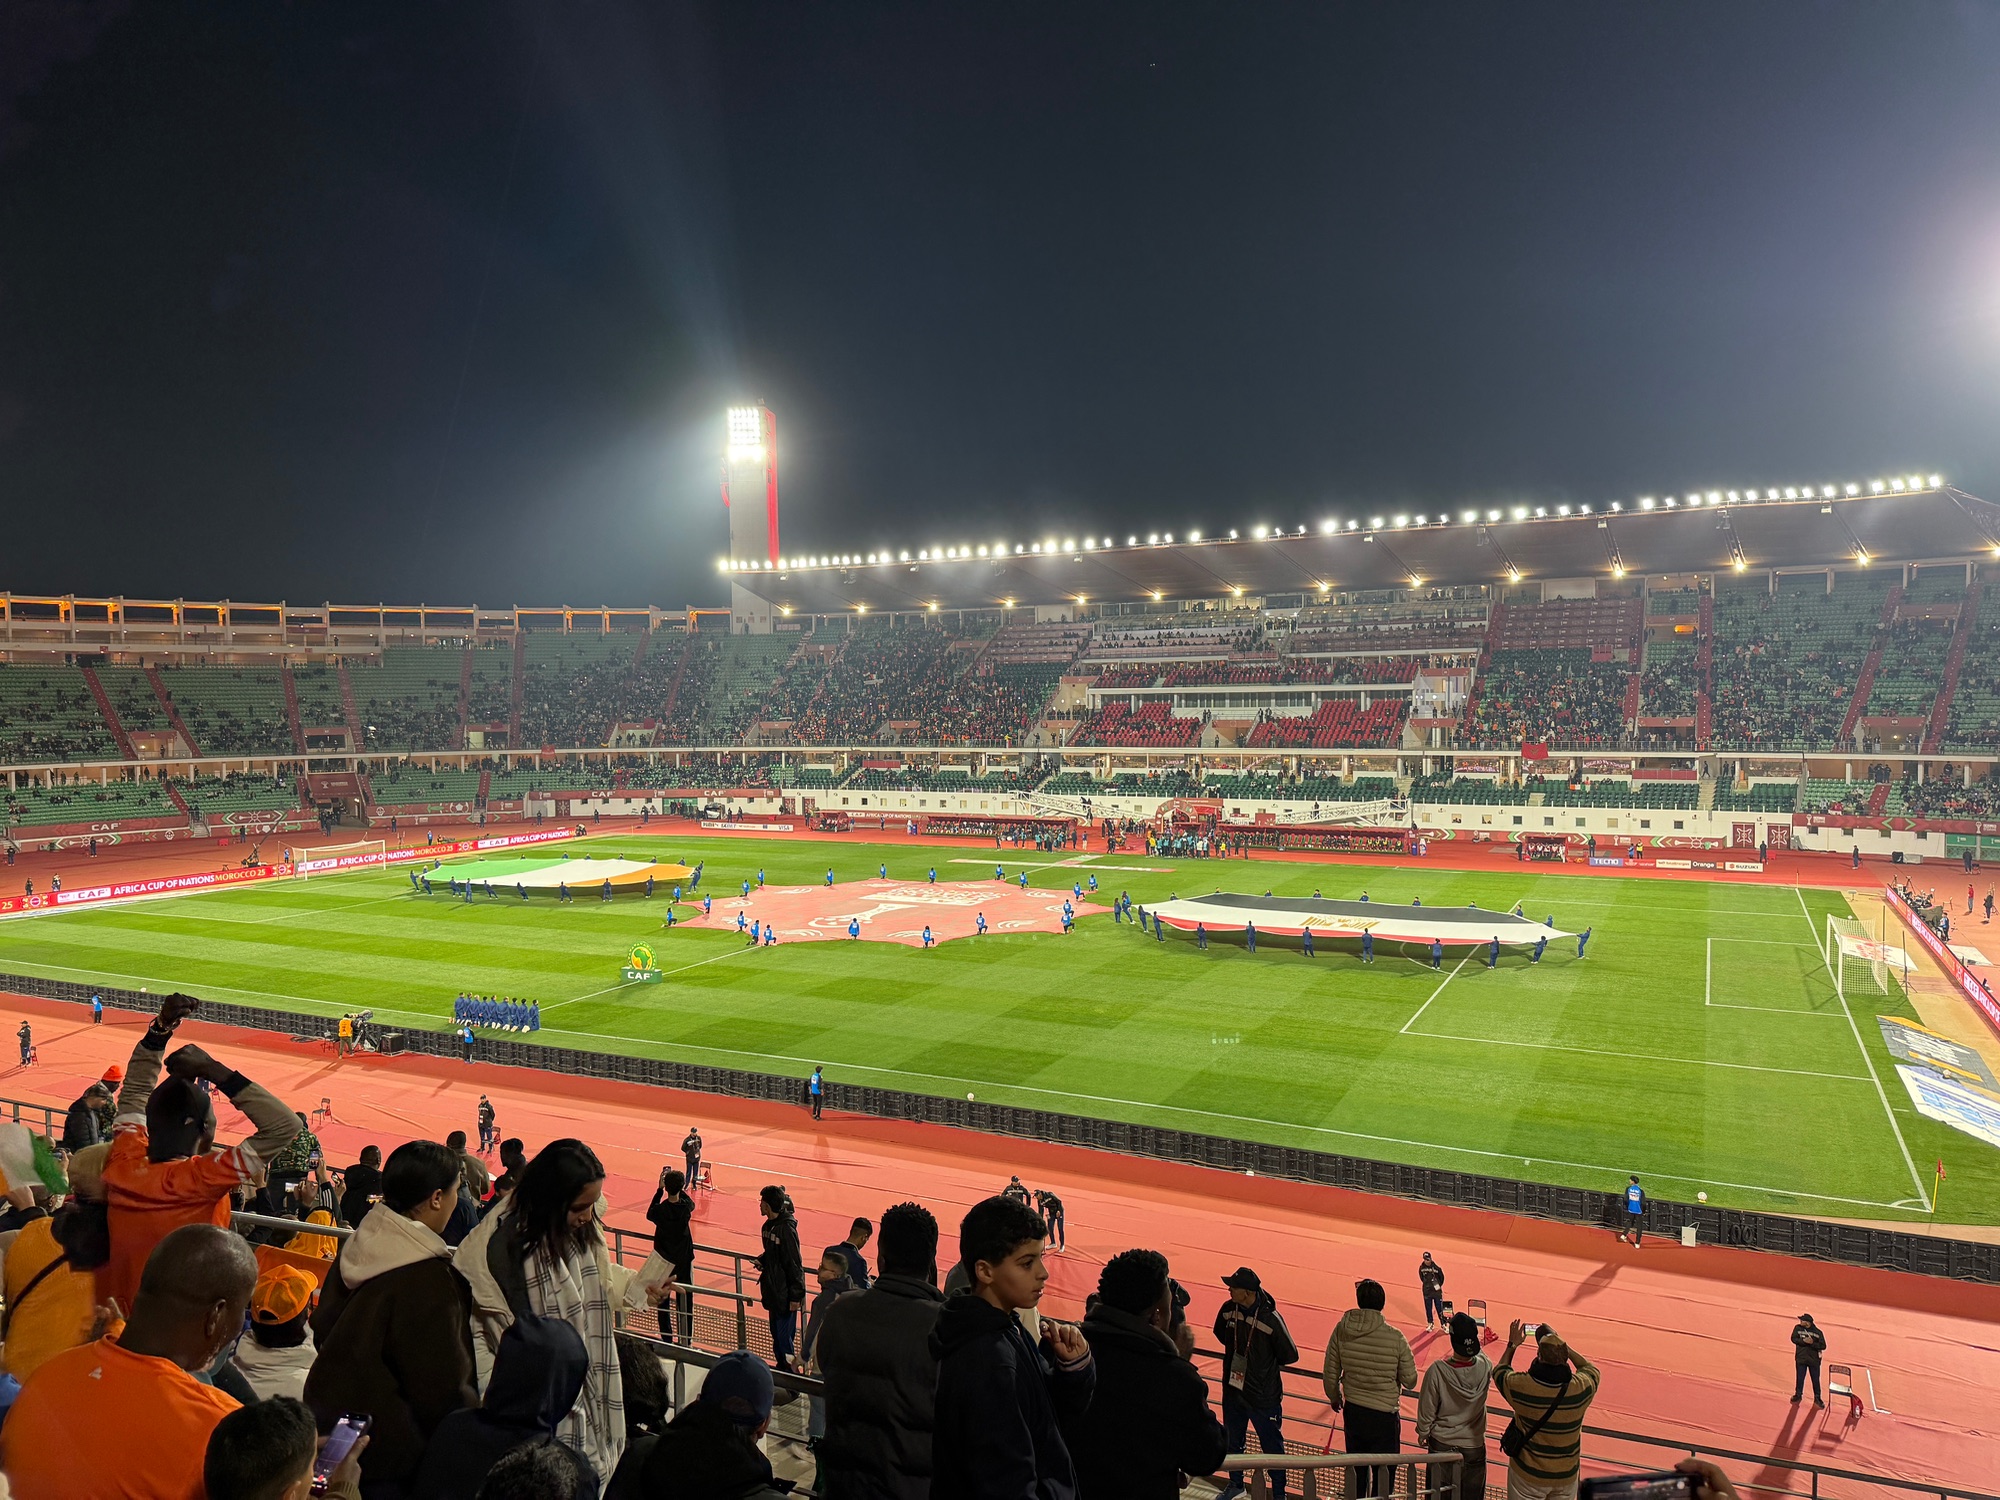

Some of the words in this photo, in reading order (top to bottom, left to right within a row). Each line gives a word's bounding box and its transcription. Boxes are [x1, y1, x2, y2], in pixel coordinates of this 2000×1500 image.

[91, 823, 119, 831] CAF
[510, 836, 530, 844] AFRICA
[548, 831, 570, 839] NATIONS
[312, 860, 334, 869] CAF
[339, 856, 364, 866] AFRICA
[364, 854, 378, 863] CUP
[387, 850, 414, 860] NATIONS
[414, 846, 446, 856] MOROCCO
[1692, 861, 1715, 869] Orange
[78, 889, 106, 899] CAF
[114, 882, 146, 895] AFRICA
[147, 881, 165, 891] CUP
[165, 879, 178, 888] OF
[178, 874, 215, 887] NATIONS
[215, 870, 257, 881] MOROCCO
[257, 868, 266, 877] 25
[2, 901, 13, 910] 25
[627, 971, 651, 980] CAF
